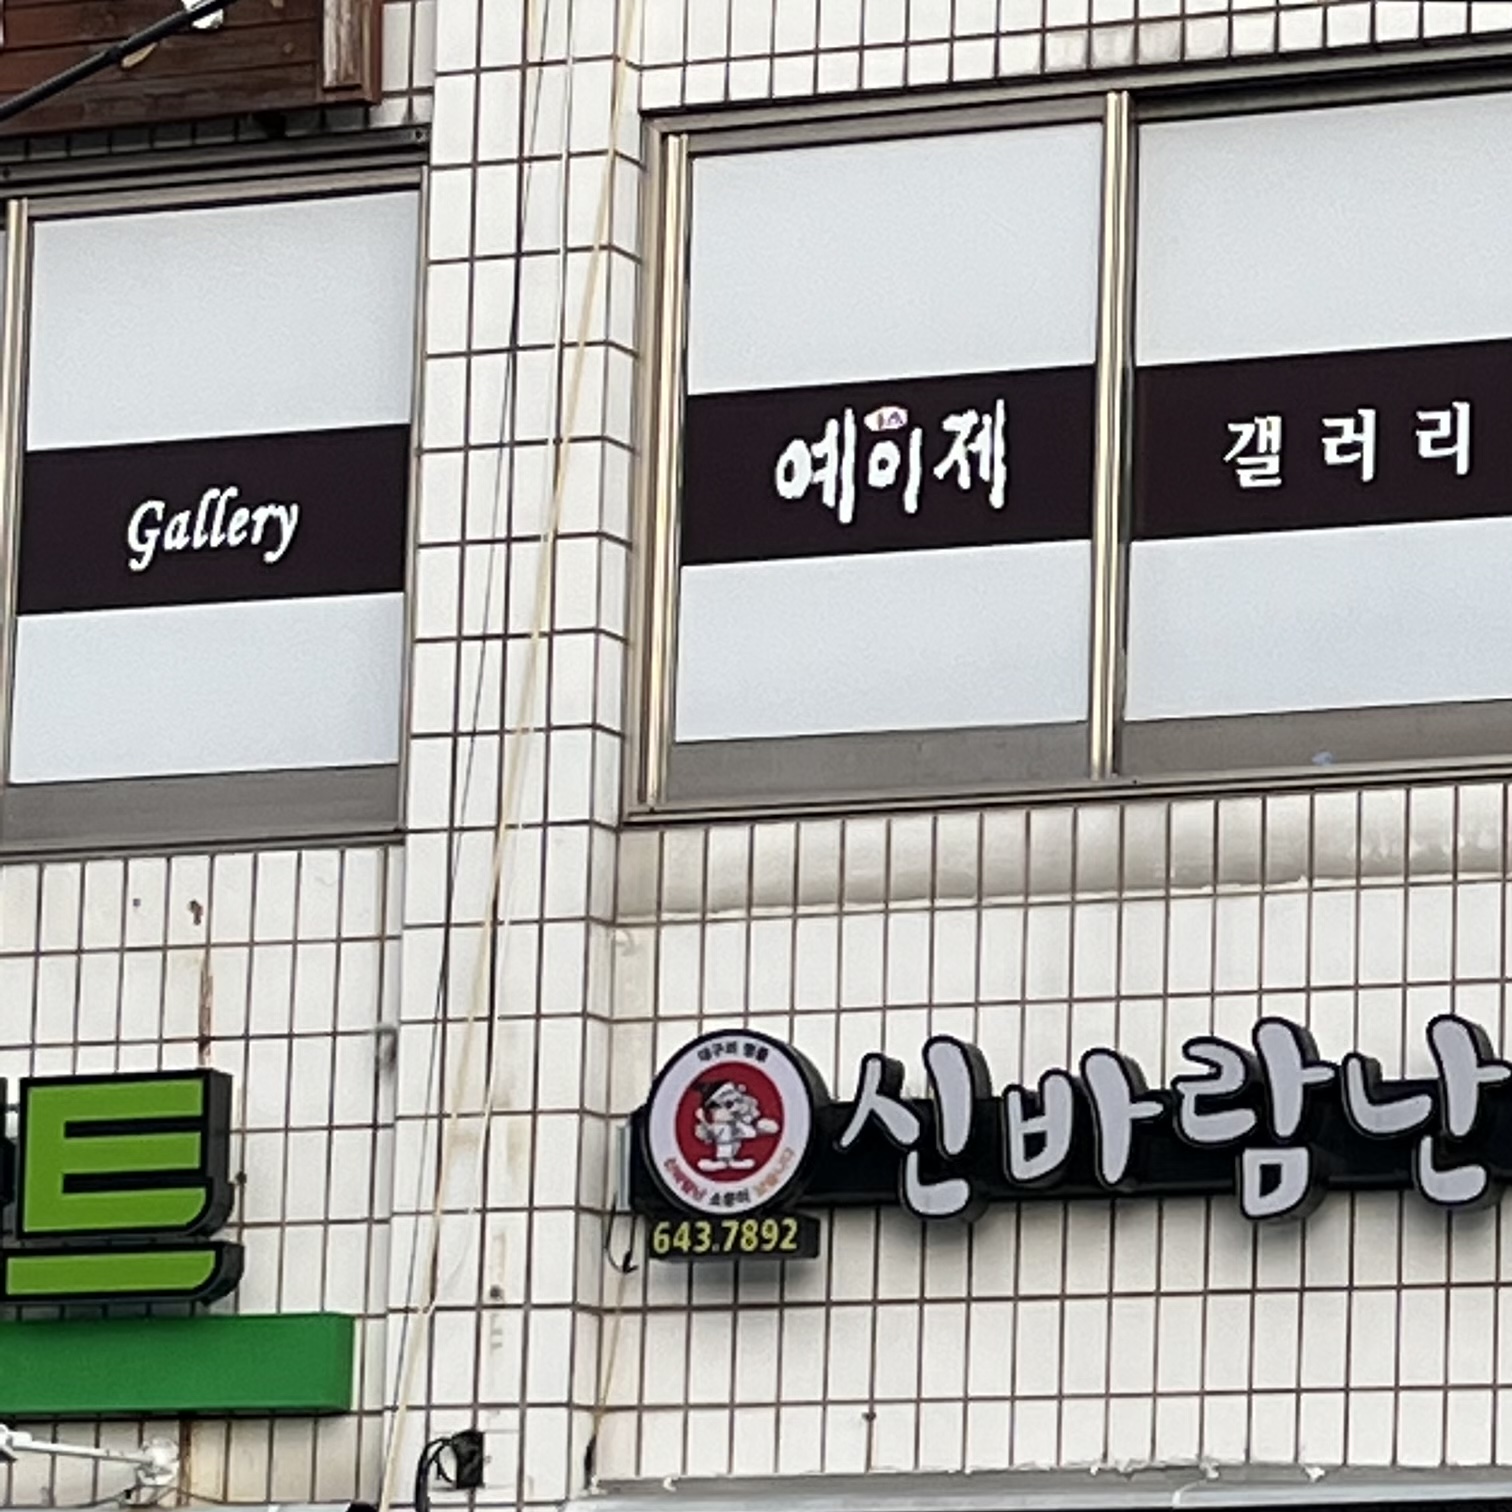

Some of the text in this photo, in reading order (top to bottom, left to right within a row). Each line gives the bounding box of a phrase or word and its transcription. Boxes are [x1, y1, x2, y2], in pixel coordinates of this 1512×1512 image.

[775, 398, 1007, 525] 예이제
[1222, 400, 1473, 490] 갤러리
[126, 485, 300, 573] Gallery
[652, 1217, 798, 1255] 643.7892
